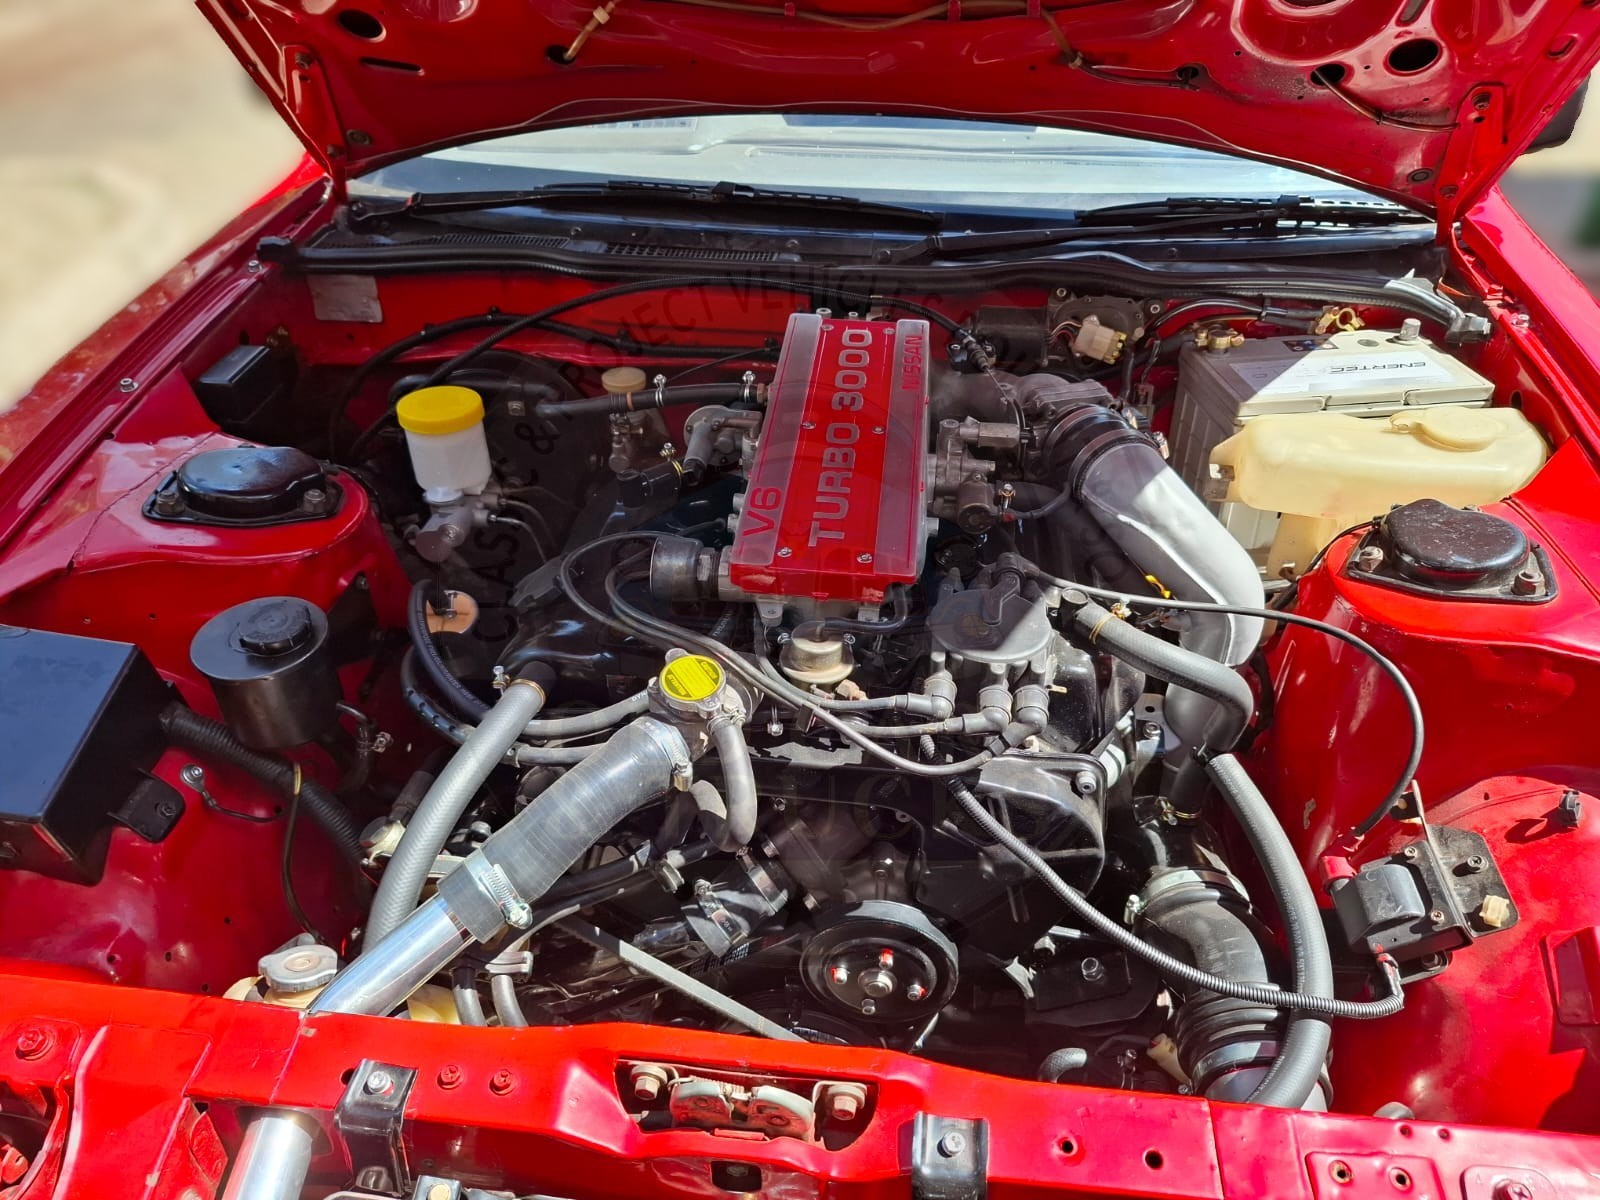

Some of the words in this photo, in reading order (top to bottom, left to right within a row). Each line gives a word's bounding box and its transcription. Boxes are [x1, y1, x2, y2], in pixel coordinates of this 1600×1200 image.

[831, 328, 873, 413] 3000
[900, 334, 923, 392] NISSAN
[1330, 361, 1426, 374] ENERTEC
[744, 486, 782, 537] V6
[809, 422, 860, 547] TURBO
